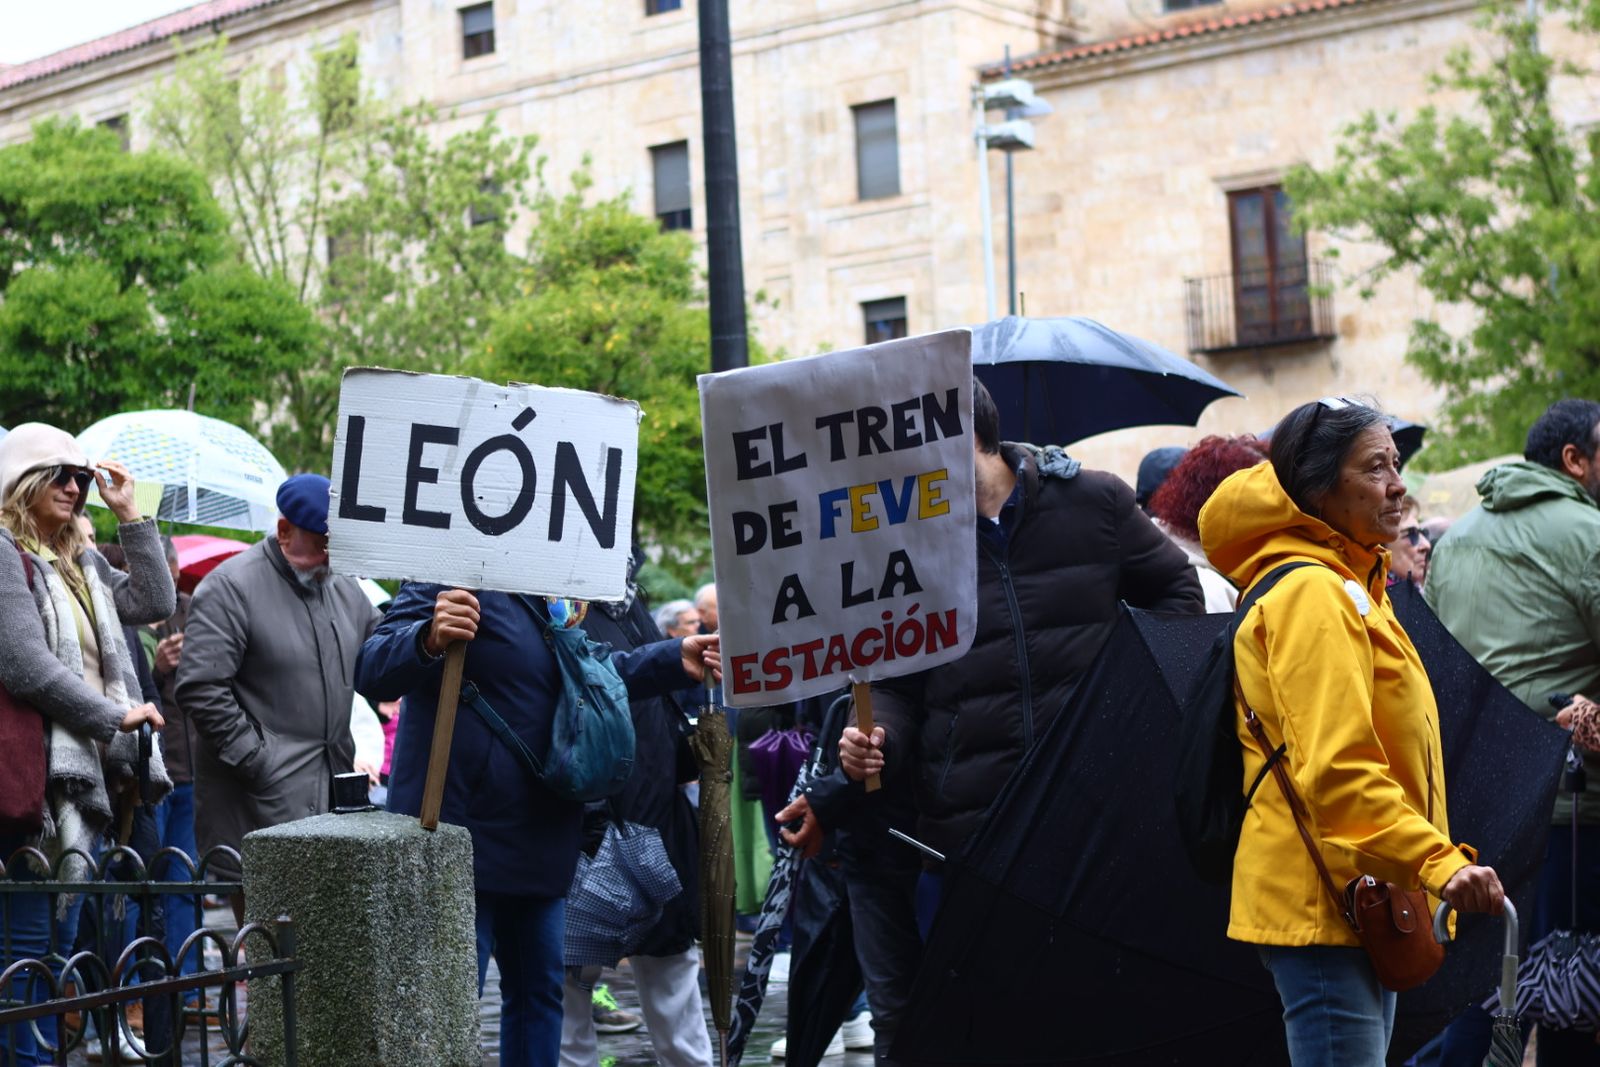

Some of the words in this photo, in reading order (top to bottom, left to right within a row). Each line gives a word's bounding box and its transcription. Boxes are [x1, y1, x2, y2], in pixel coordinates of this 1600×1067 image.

[339, 406, 622, 549] LEÓN
[732, 422, 808, 481] EL
[815, 387, 964, 462] TREN
[732, 500, 802, 556] DE
[818, 468, 950, 540] FEVE
[772, 573, 816, 625] A
[841, 549, 923, 609] LA
